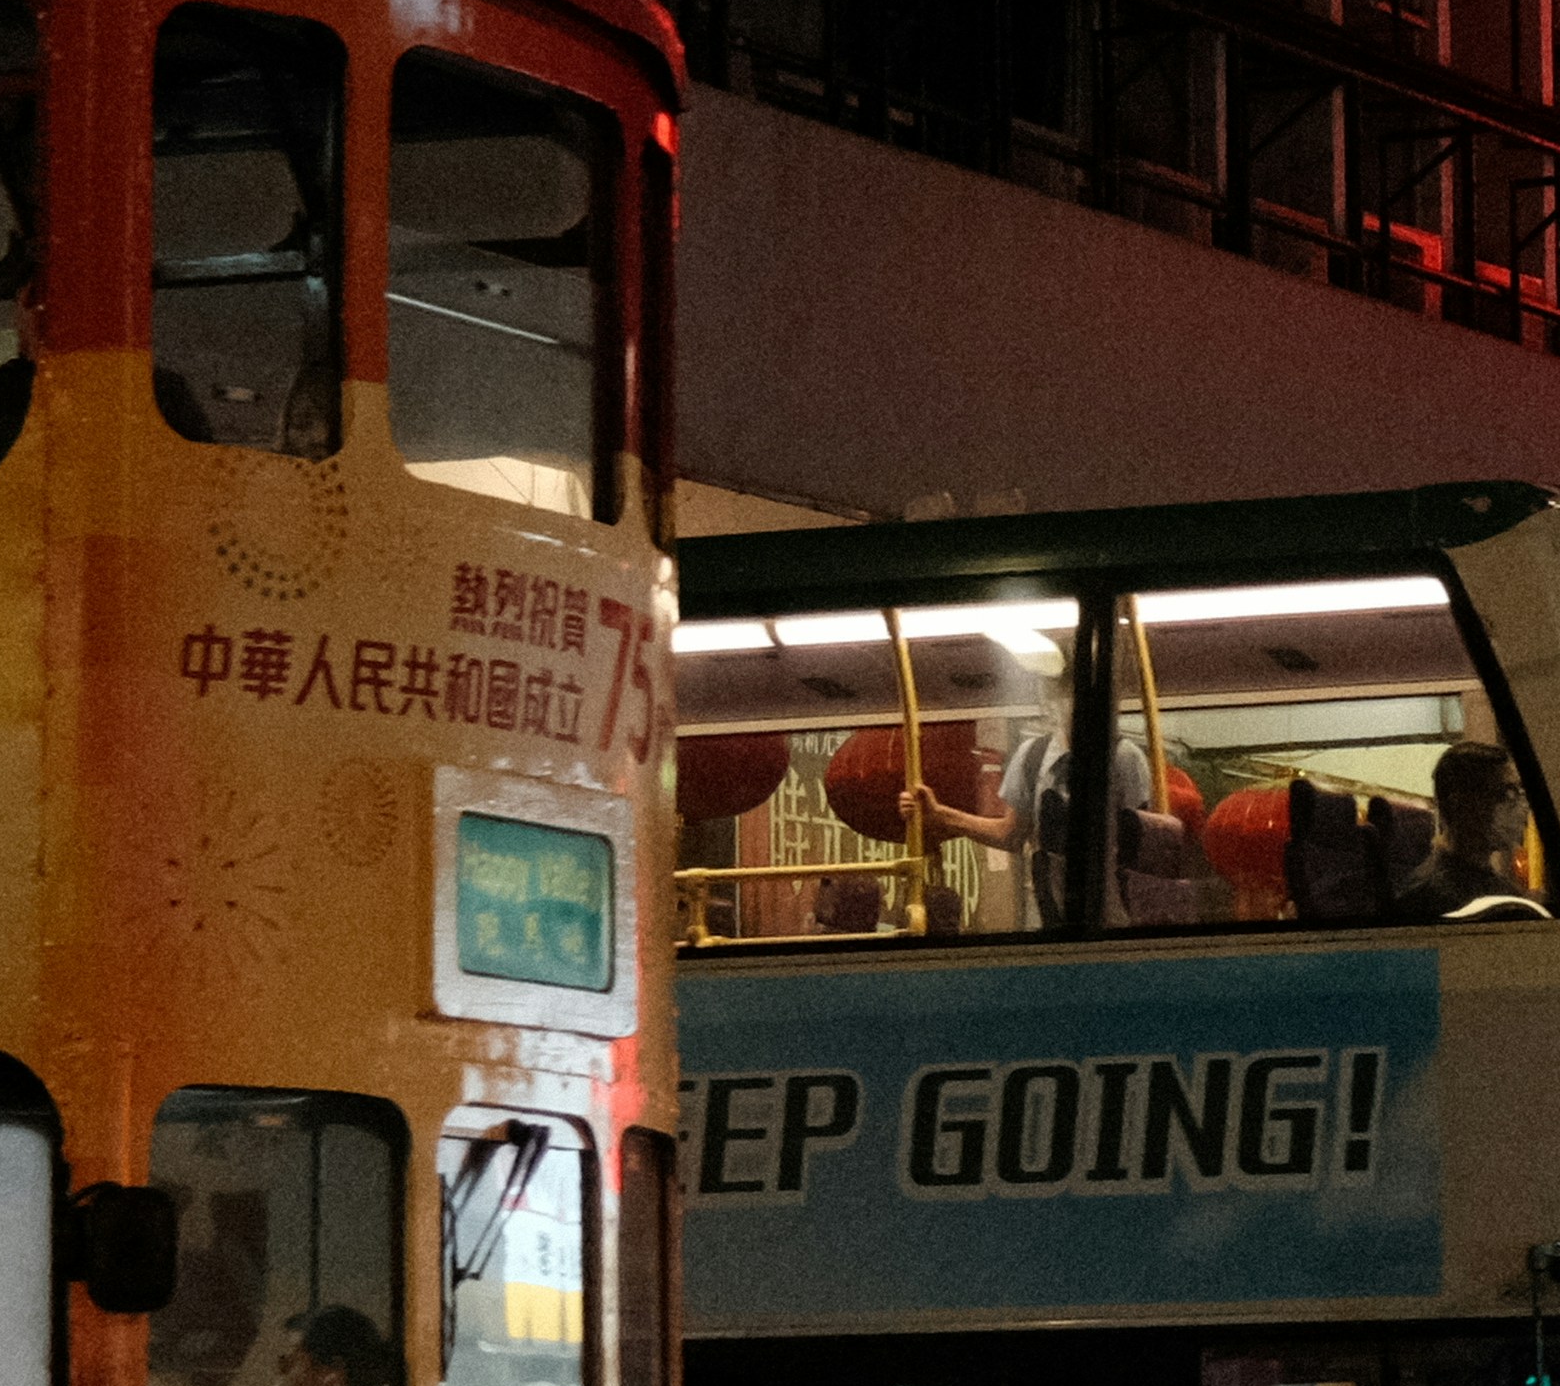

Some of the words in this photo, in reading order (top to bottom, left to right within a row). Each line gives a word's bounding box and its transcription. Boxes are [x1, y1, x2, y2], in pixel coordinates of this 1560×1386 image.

[451, 561, 591, 657] 熱烈祝賀
[180, 623, 585, 745] 中華人民共和國成立
[677, 1073, 858, 1196] EP
[908, 1050, 1382, 1187] GOING!
